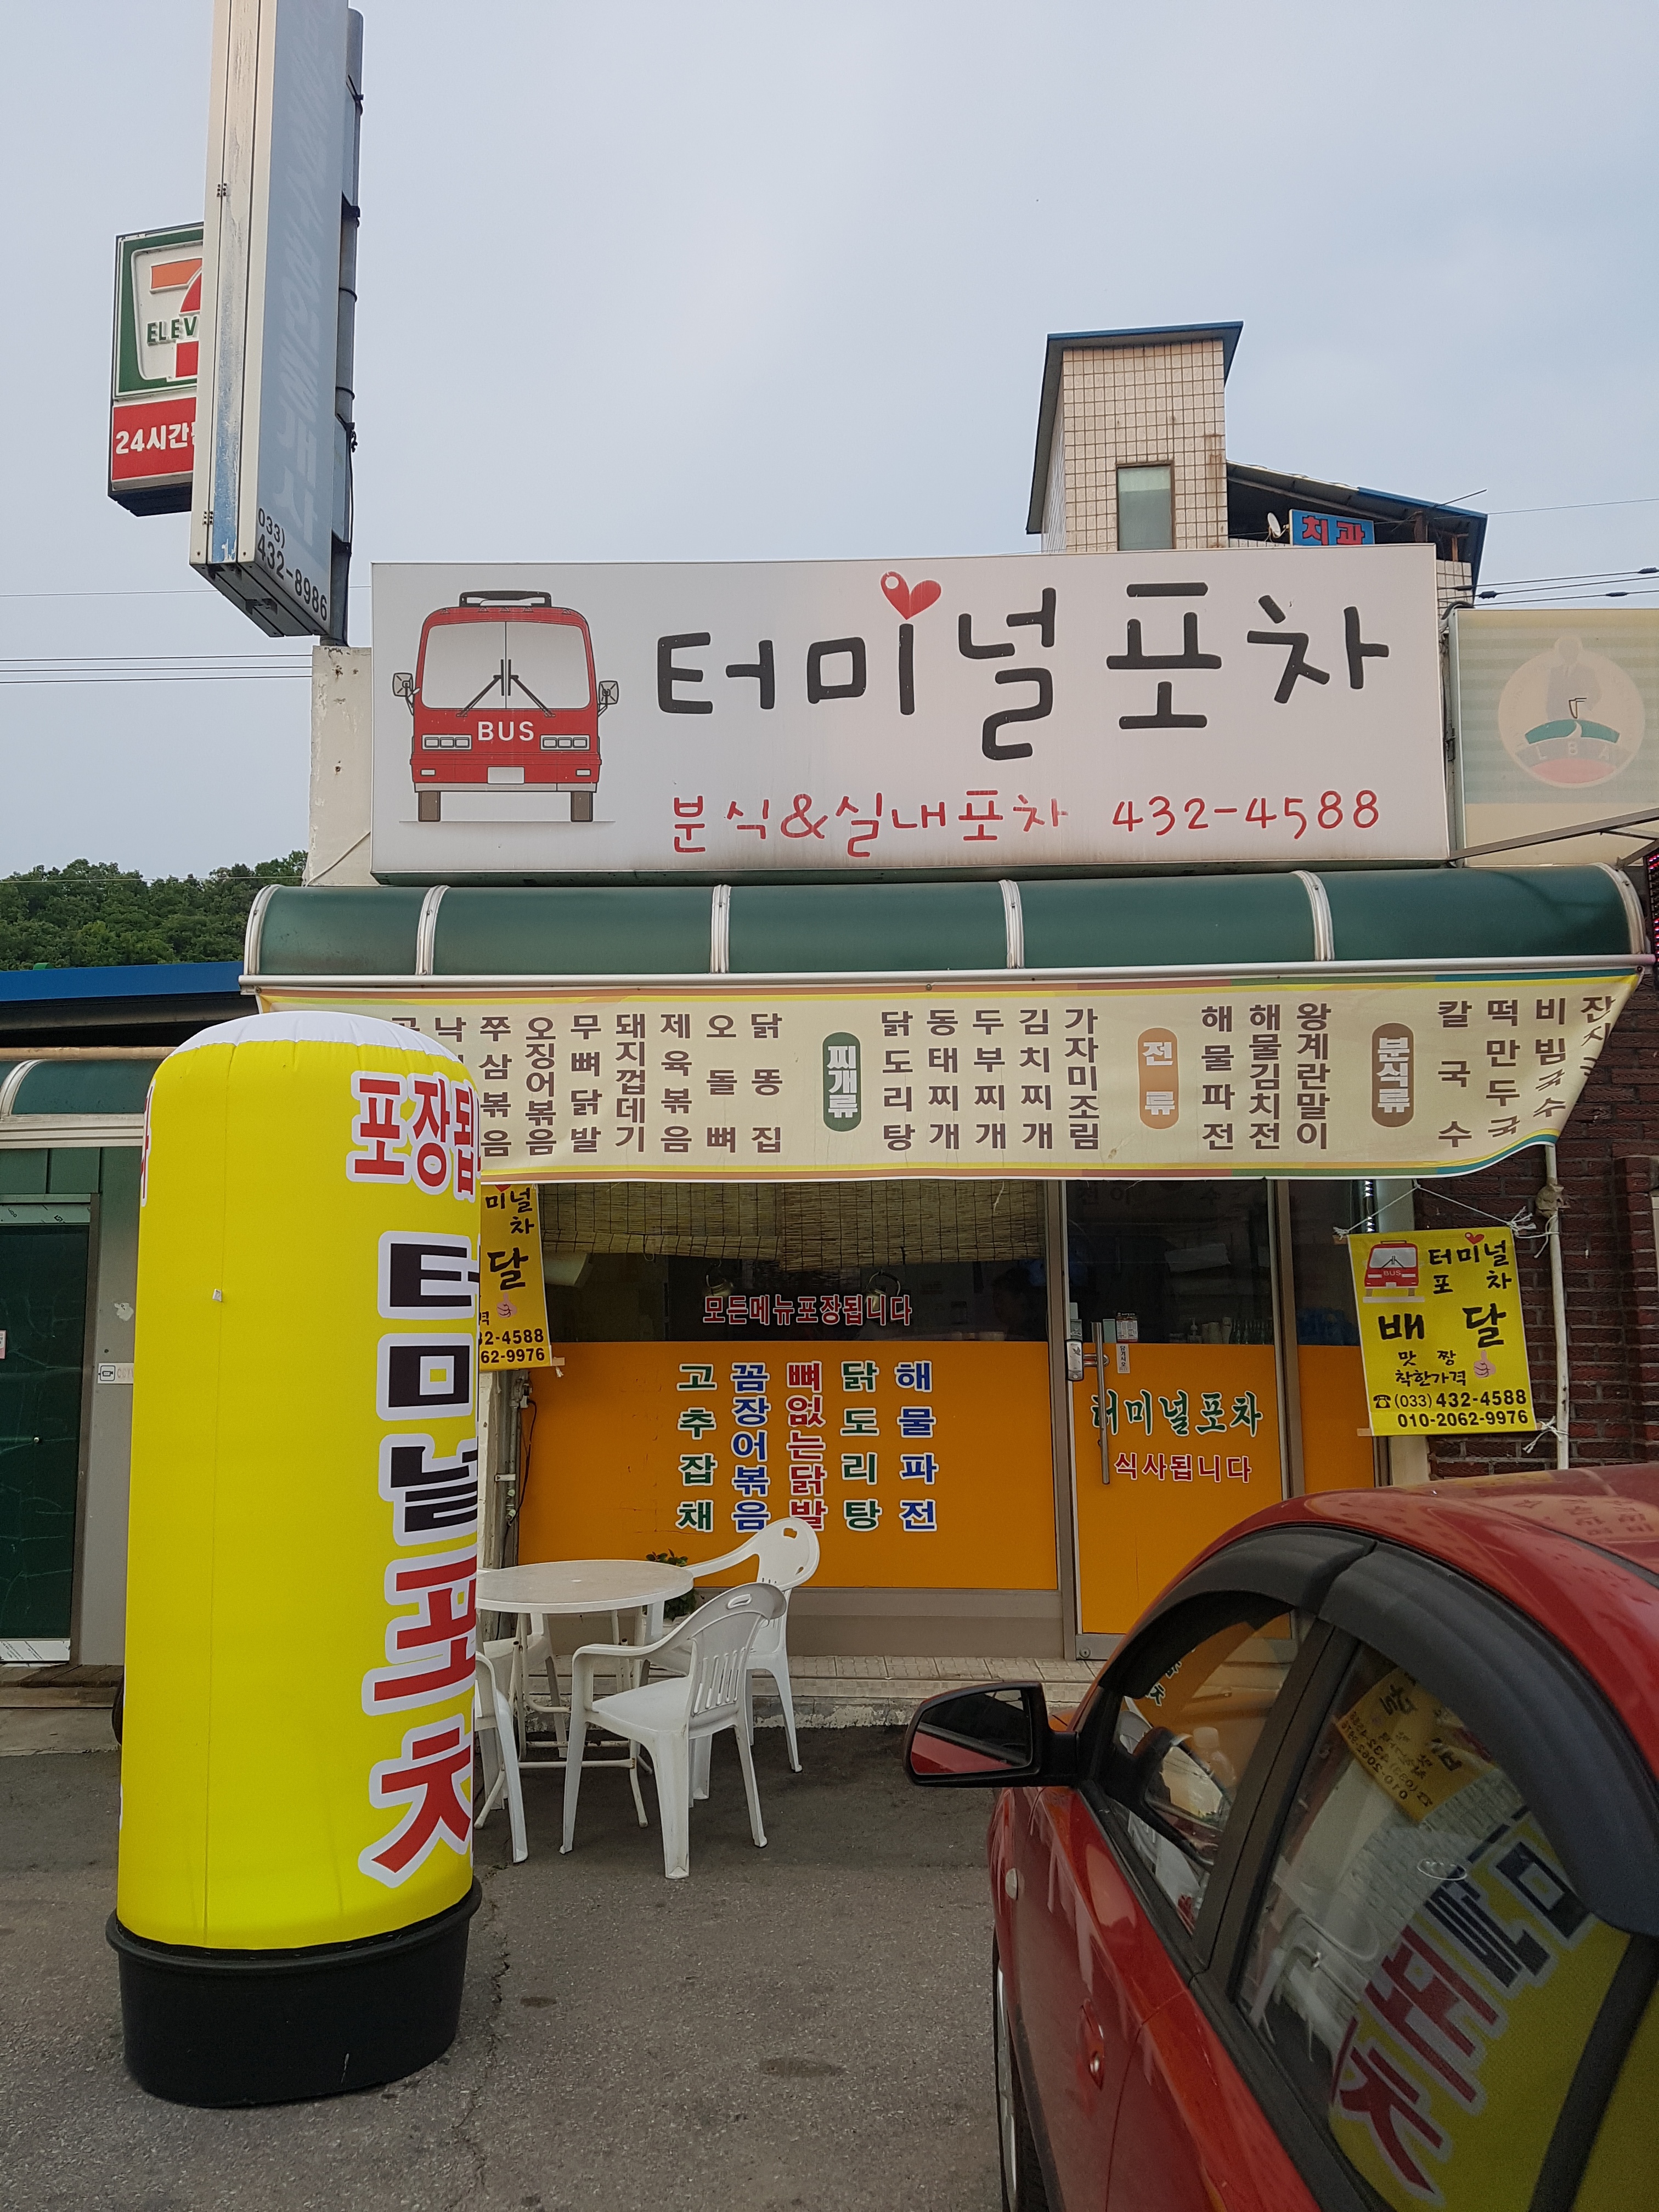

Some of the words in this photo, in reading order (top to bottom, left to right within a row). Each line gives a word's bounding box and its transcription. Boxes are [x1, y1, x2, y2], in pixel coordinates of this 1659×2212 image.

[147, 316, 198, 344] ELEV
[116, 422, 195, 455] 24시간
[257, 534, 327, 621] 432-8986
[1302, 515, 1365, 545] 치과
[477, 720, 535, 742] BUS
[1112, 789, 1379, 839] 432-4588
[478, 1016, 512, 1157] 쭈삼볶음
[525, 1017, 557, 1155] 오징어볶음
[570, 1015, 602, 1153] 무뼈닭발
[615, 1013, 646, 1153] 돼지껍데기
[660, 1013, 692, 1153] 제육볶음
[706, 1014, 737, 1153] 오돌뼈
[751, 1013, 783, 1154] 닭똥집
[827, 1045, 858, 1119] 찌개류
[881, 1009, 915, 1151] 닭도리탕
[926, 1009, 960, 1149] 동태찌개
[972, 1009, 1006, 1149] 두부찌개
[1019, 1009, 1053, 1149] 김치찌개
[1064, 1008, 1099, 1150] 가자미조림
[1201, 1005, 1235, 1150] 해물파전
[1249, 1004, 1282, 1150] 해물김치전
[1296, 1003, 1331, 1150] 왕계란말이
[1377, 1037, 1411, 1113] 분식류
[1437, 1001, 1472, 1147] 칼국수
[1486, 1000, 1521, 1138] 떡만두국
[1533, 998, 1566, 1118] 비빔국수
[354, 1077, 481, 1196] 포장됩
[487, 1247, 529, 1291] 달
[1429, 1240, 1509, 1267] 터미널
[840, 1361, 882, 1532] 닭도리탕
[894, 1360, 939, 1532] 해물파전
[1091, 1389, 1263, 1437] 터미널포차
[1395, 1369, 1466, 1387] 착한가격
[1398, 1410, 1529, 1427] 010-2062-9976
[676, 1363, 717, 1532] 고추잡채
[731, 1362, 771, 1533] 꼼장어볶음
[1114, 1452, 1252, 1483] 식사됩니다
